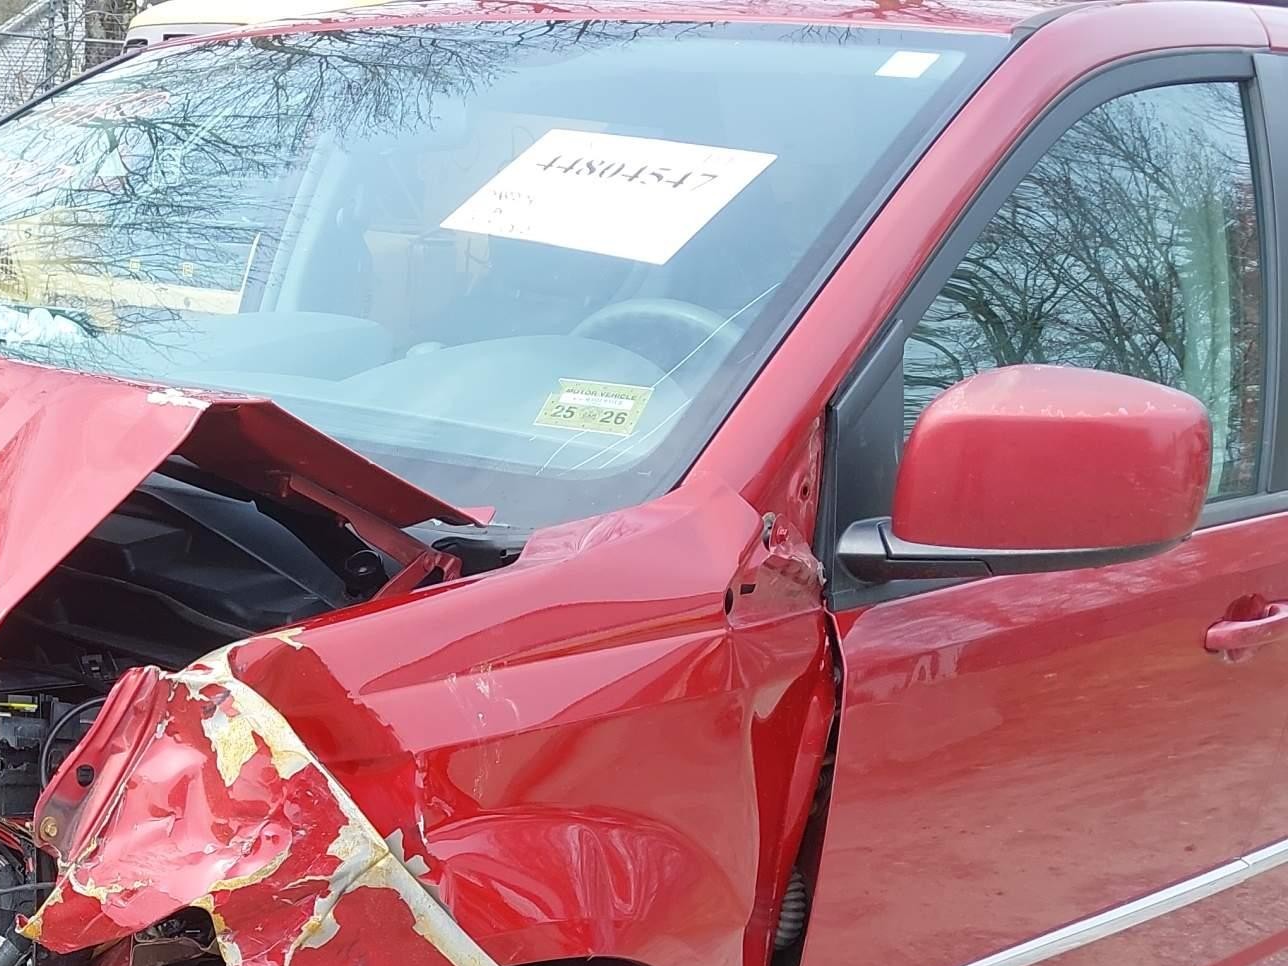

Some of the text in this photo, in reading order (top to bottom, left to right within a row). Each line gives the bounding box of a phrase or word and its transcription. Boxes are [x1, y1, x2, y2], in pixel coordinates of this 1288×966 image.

[535, 155, 719, 191] 44804547
[601, 391, 638, 401] VEHICLE
[551, 404, 578, 419] 25
[599, 410, 628, 425] 26
